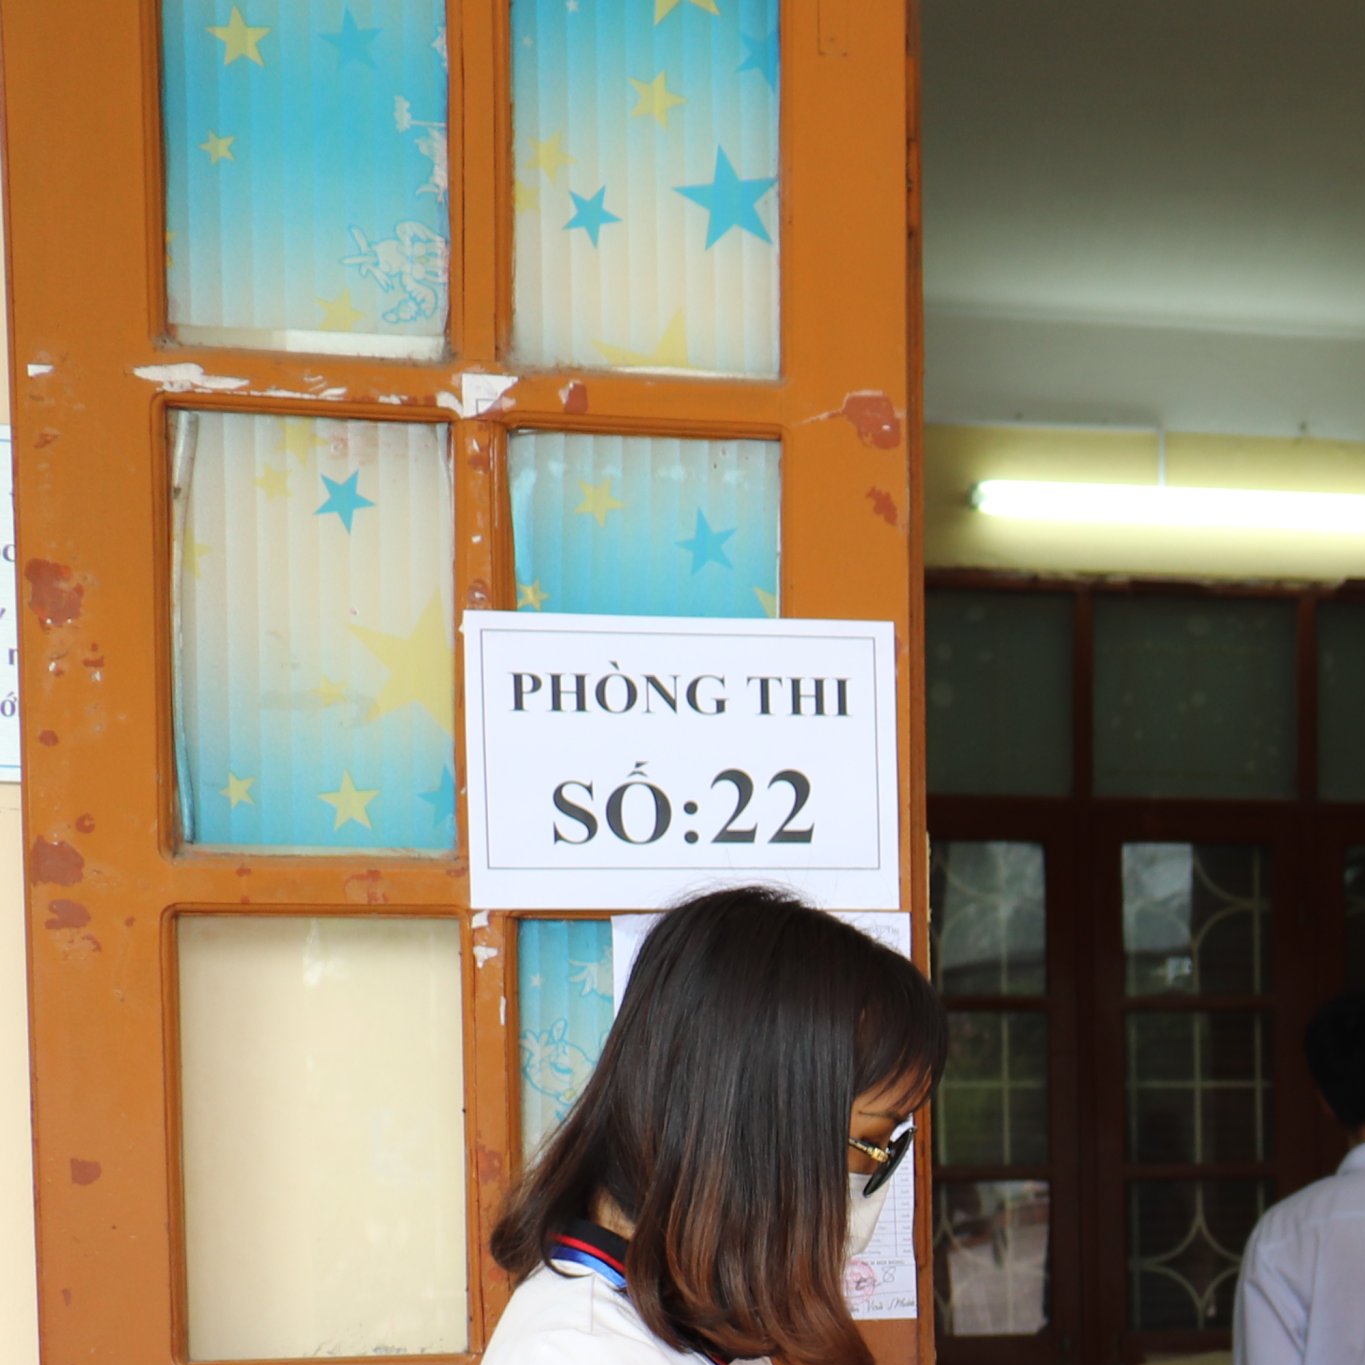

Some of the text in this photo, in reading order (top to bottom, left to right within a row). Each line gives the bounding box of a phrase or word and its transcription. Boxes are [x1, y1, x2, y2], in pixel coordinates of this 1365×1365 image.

[508, 660, 852, 718] PHÒNG THI
[552, 761, 816, 846] SỐ:22
